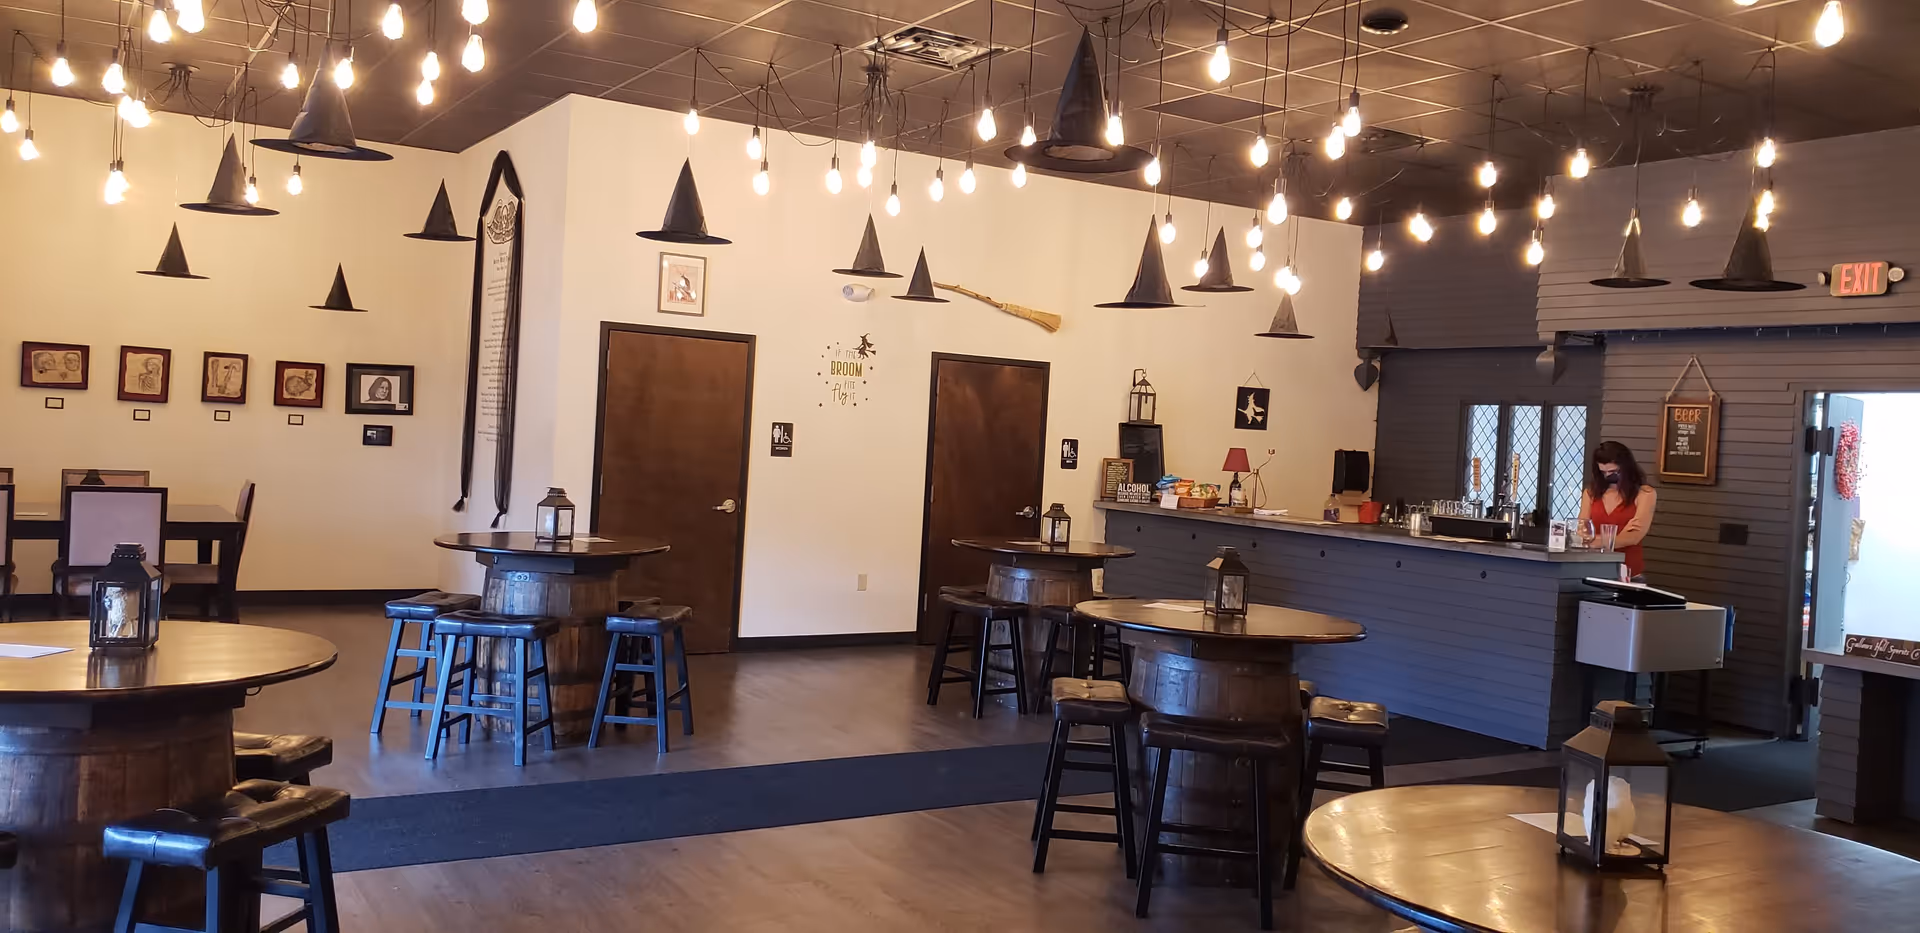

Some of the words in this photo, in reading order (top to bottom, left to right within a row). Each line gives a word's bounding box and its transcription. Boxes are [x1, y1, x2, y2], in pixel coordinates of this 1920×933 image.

[1840, 262, 1882, 294] EXIT
[831, 360, 863, 377] BROOM
[832, 382, 848, 406] fly
[1118, 483, 1150, 493] ALCOHOL
